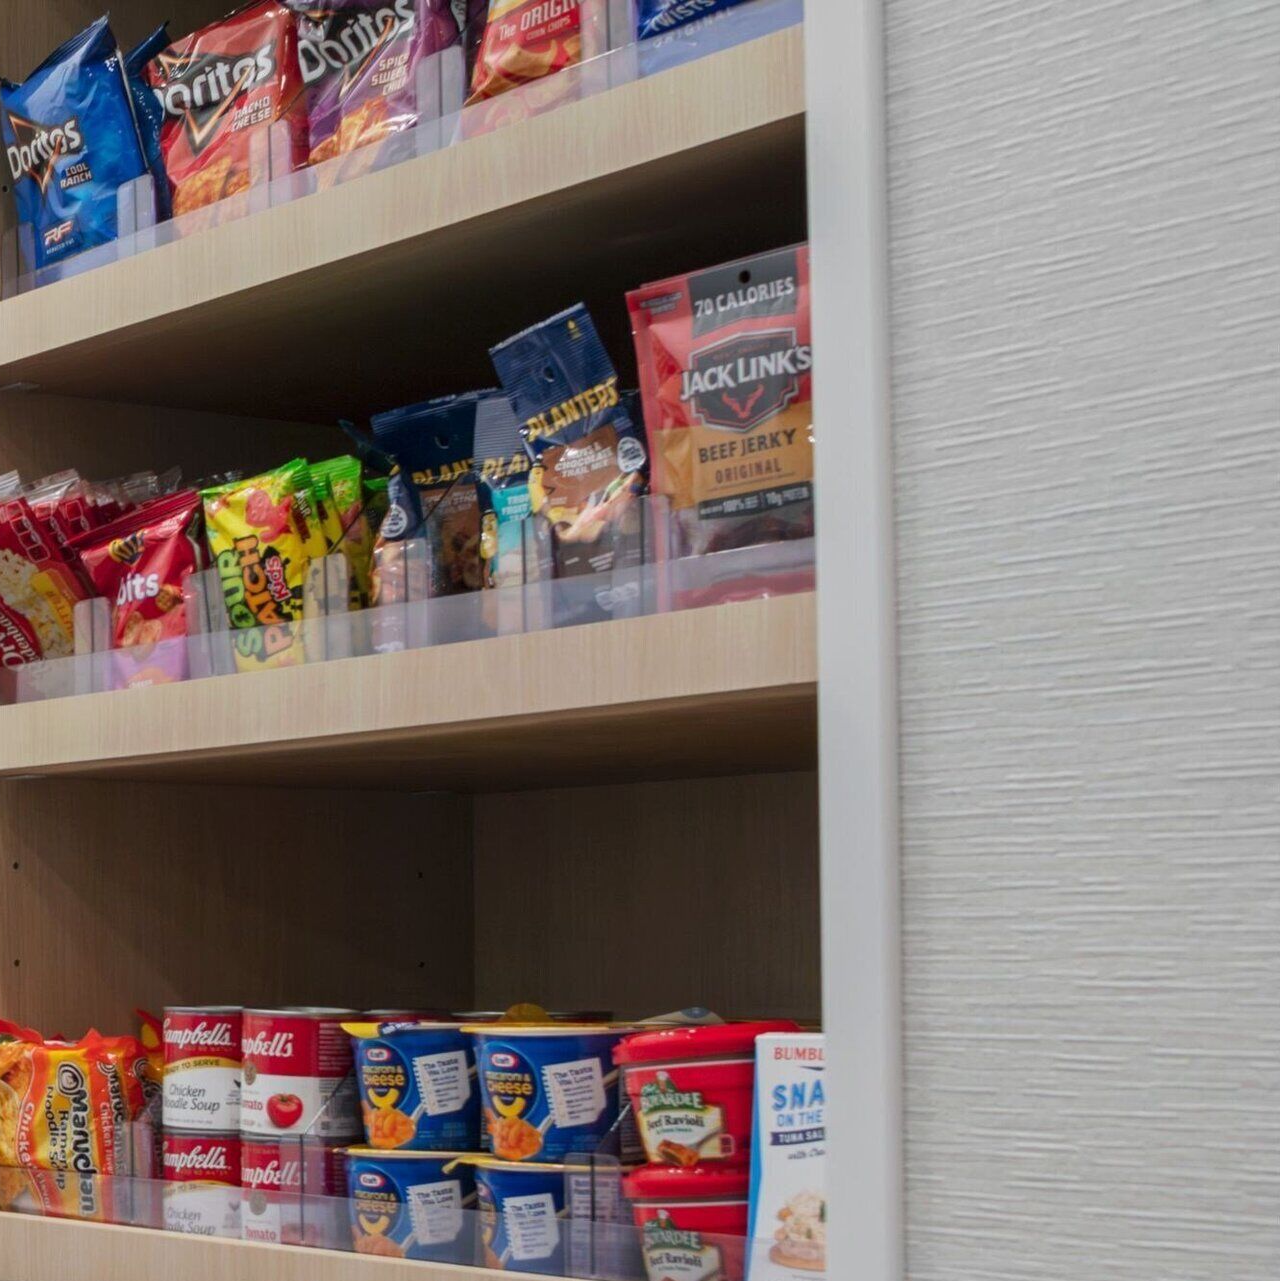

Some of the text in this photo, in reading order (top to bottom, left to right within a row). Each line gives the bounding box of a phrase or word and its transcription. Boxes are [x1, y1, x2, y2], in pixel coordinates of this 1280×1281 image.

[298, 0, 415, 83] Doritos
[498, 22, 517, 39] The
[232, 95, 270, 120] NACHO
[232, 106, 271, 131] CHEESE
[7, 116, 82, 181] Doritos
[60, 172, 93, 188] RANCH
[65, 162, 88, 176] COOL
[694, 297, 713, 319] 70
[715, 275, 795, 315] CALORIES
[680, 344, 812, 401] JACK LINK'S
[525, 374, 619, 443] PLANTERS
[698, 427, 797, 465] BEEF JERKY
[714, 460, 783, 486] ORIGINAL
[116, 572, 160, 606] bits
[217, 549, 265, 658] SOUR
[233, 534, 294, 661] PATCH
[552, 1065, 596, 1083] The Taste
[577, 1073, 597, 1086] Love
[168, 1083, 206, 1098] Chicken
[771, 1078, 825, 1112] SNA
[45, 1086, 59, 1148] Noodle
[190, 1097, 221, 1115] Soup
[776, 1109, 823, 1128] ON THE
[99, 1102, 113, 1147] Chicken
[779, 1132, 803, 1144] TUNA
[70, 1088, 97, 1217] Maruchan
[669, 1252, 703, 1271] Ravioli
